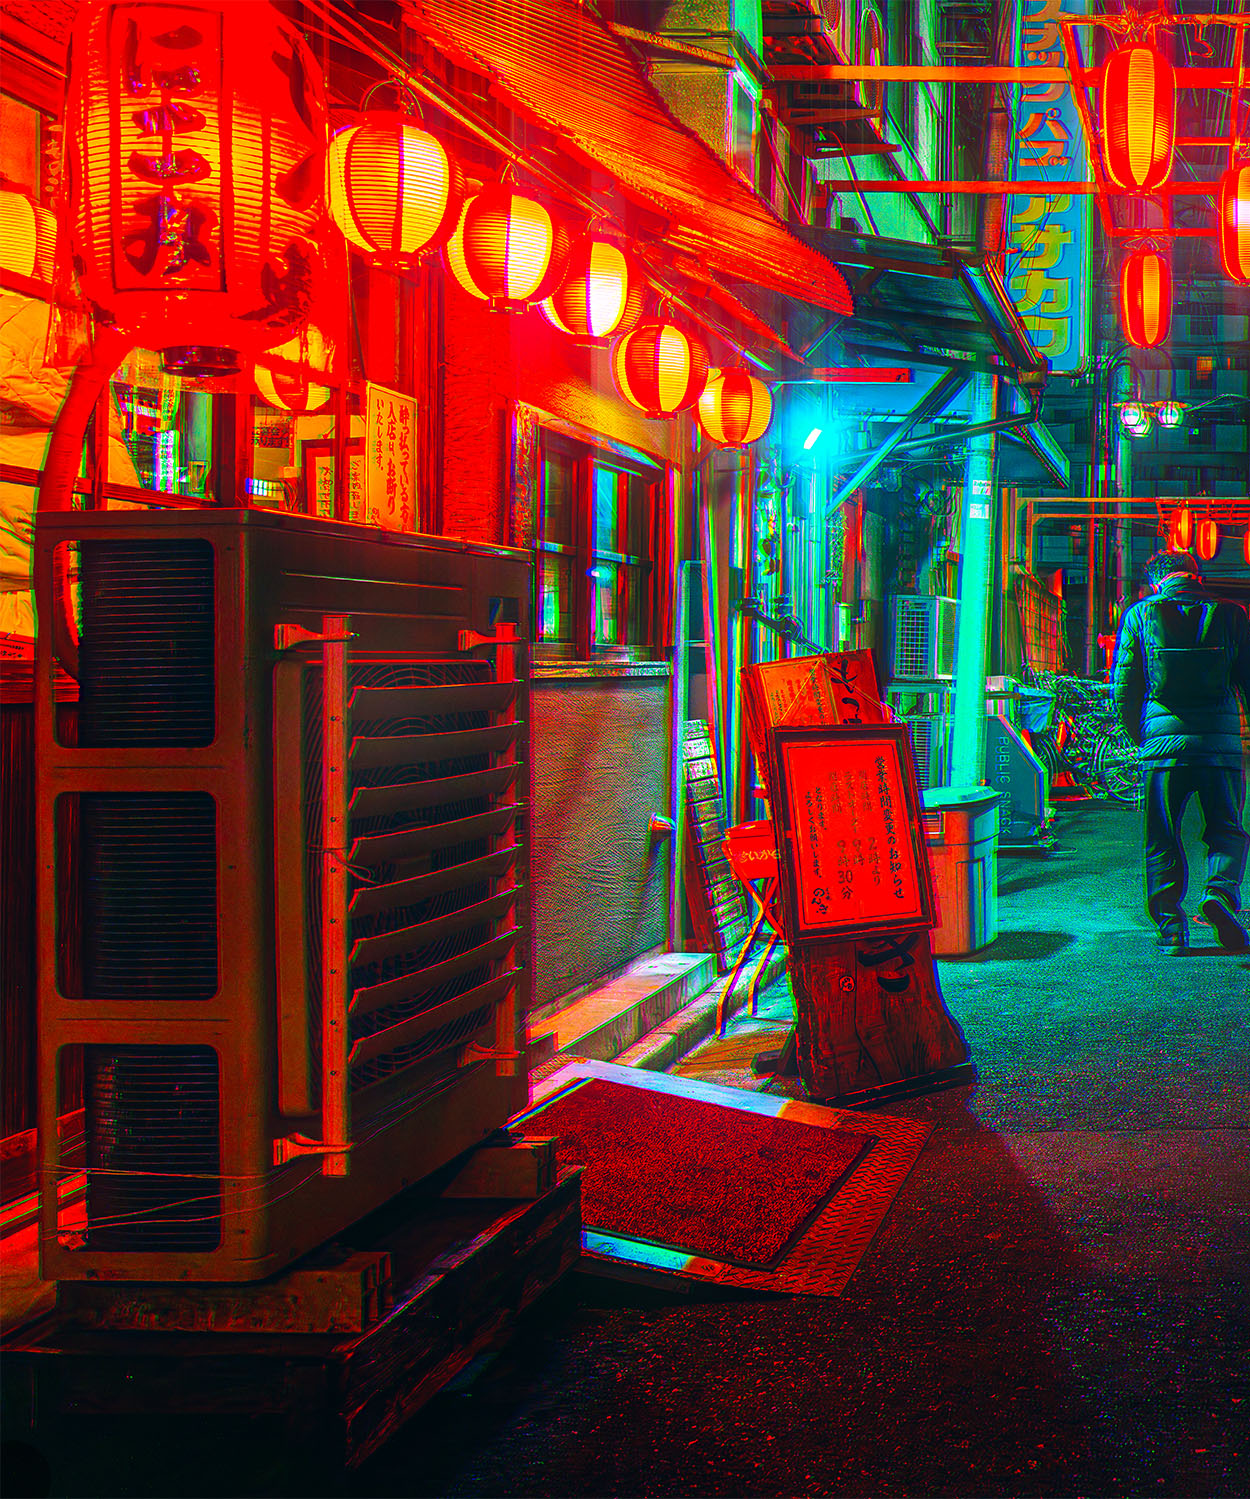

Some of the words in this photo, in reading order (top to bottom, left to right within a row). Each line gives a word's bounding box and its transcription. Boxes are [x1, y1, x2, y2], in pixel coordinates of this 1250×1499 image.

[997, 736, 1011, 784] PUBLIC
[843, 770, 859, 833] ラストオーダー
[874, 755, 905, 899] 営業時間変更のお知らせ
[999, 791, 1012, 834] SNACK
